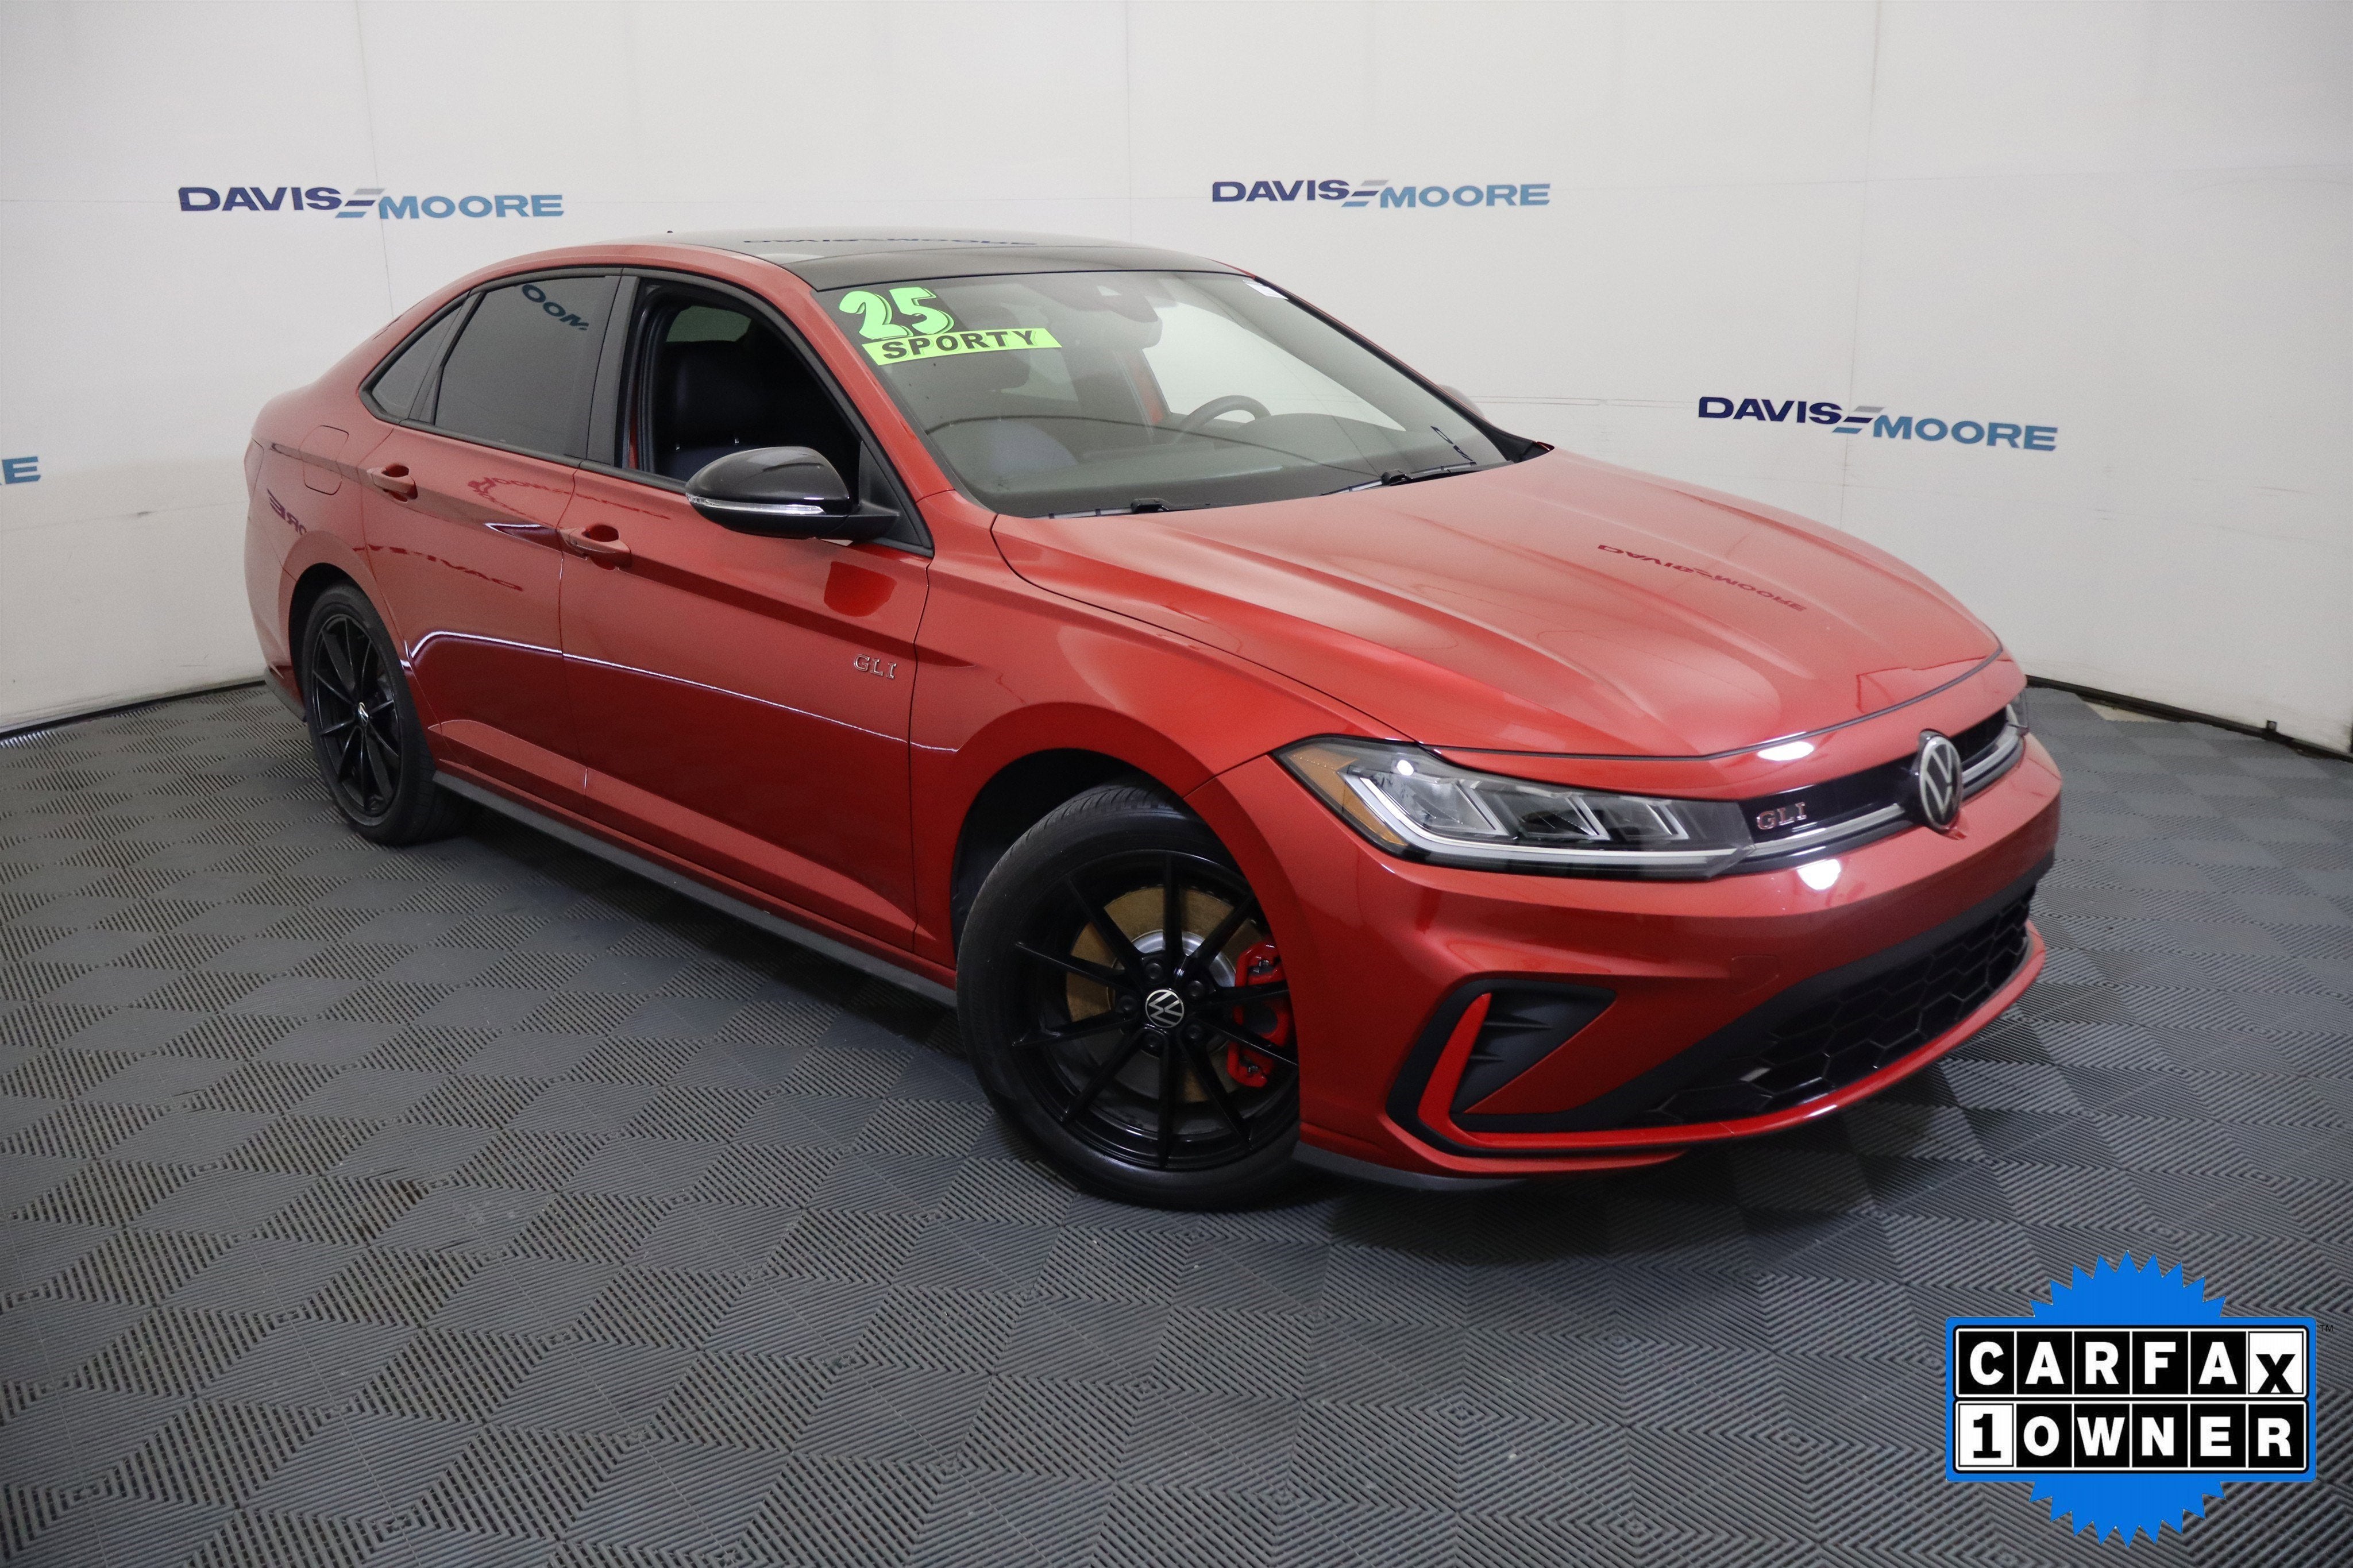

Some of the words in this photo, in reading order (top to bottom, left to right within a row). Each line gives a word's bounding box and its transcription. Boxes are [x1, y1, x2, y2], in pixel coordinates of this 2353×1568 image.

[178, 187, 342, 211] DAVIS
[378, 194, 564, 219] MOORE
[1212, 179, 1350, 202] DAVIS
[1380, 183, 1550, 208] MOORE
[839, 287, 955, 340] 25
[882, 330, 1036, 359] SPORTY
[1698, 396, 1843, 425] DAVIS
[1873, 414, 2058, 451] MOORE
[0, 456, 41, 484] E
[853, 654, 897, 679] GLI
[1756, 801, 1807, 831] GLI
